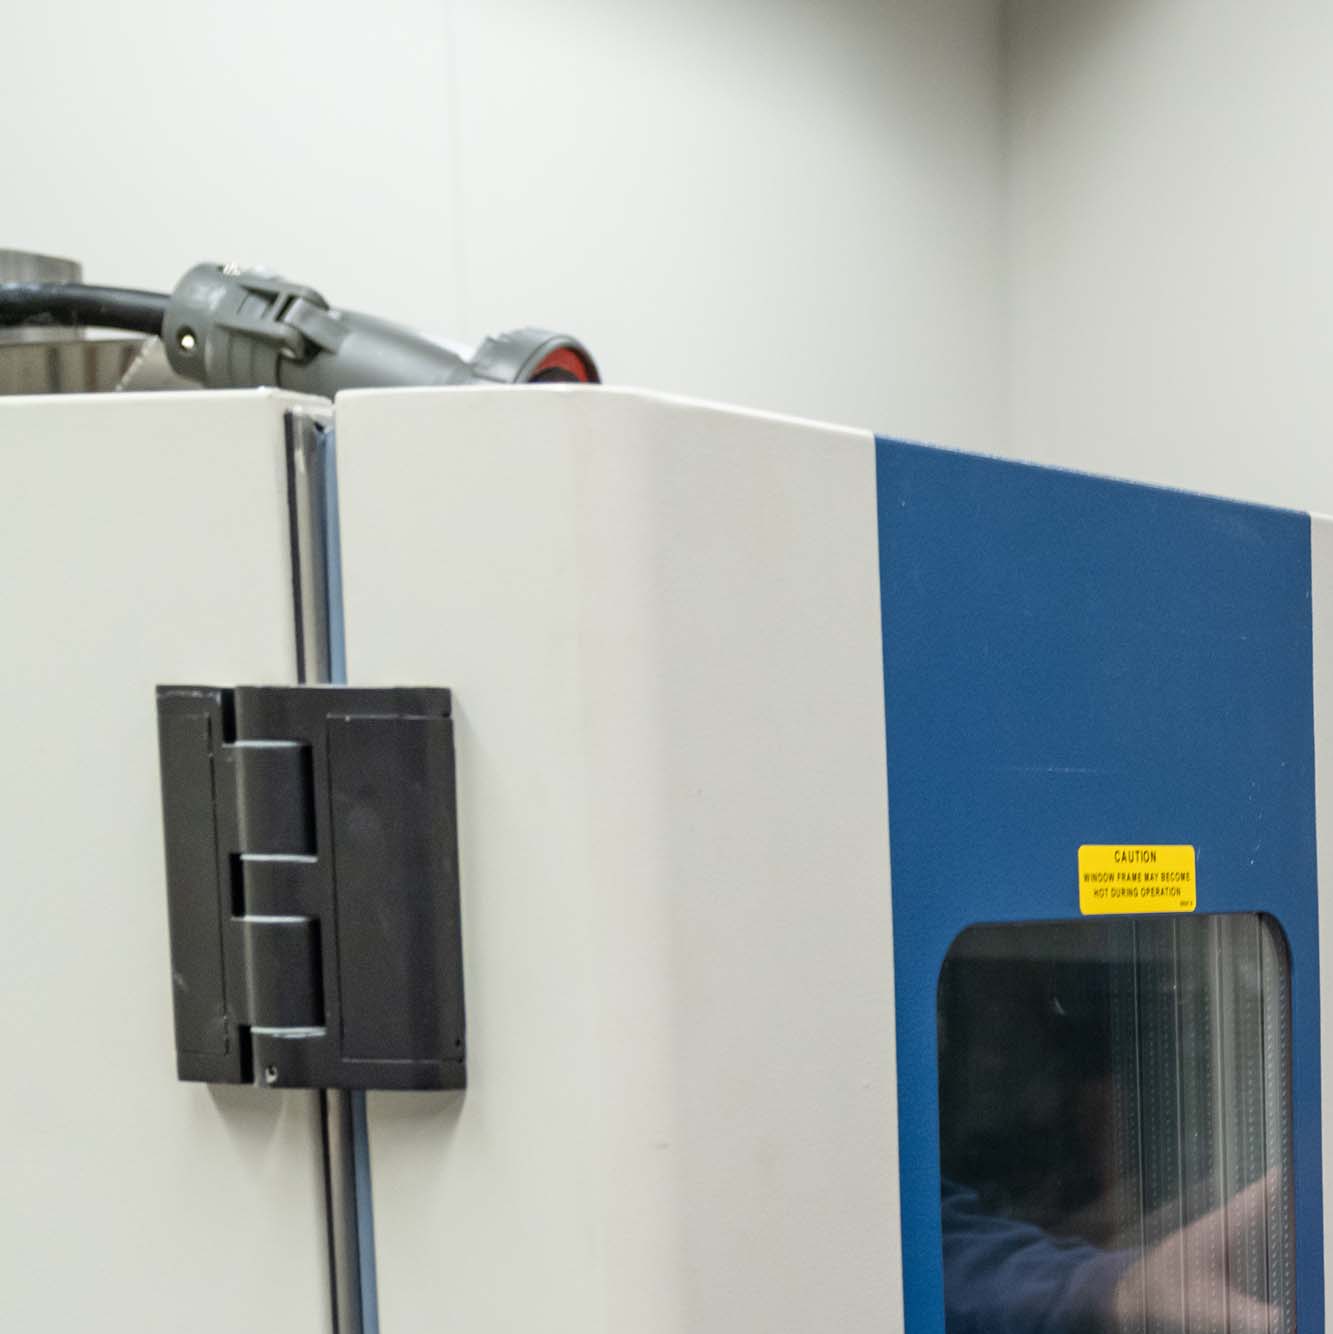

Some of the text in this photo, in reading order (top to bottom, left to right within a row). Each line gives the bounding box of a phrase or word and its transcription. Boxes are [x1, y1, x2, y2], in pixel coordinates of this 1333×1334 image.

[1114, 850, 1157, 863] CAUTION
[1083, 871, 1190, 883] WINDOW FRAME MAY BECOME
[1094, 886, 1181, 898] HOT DURING OPERATION
